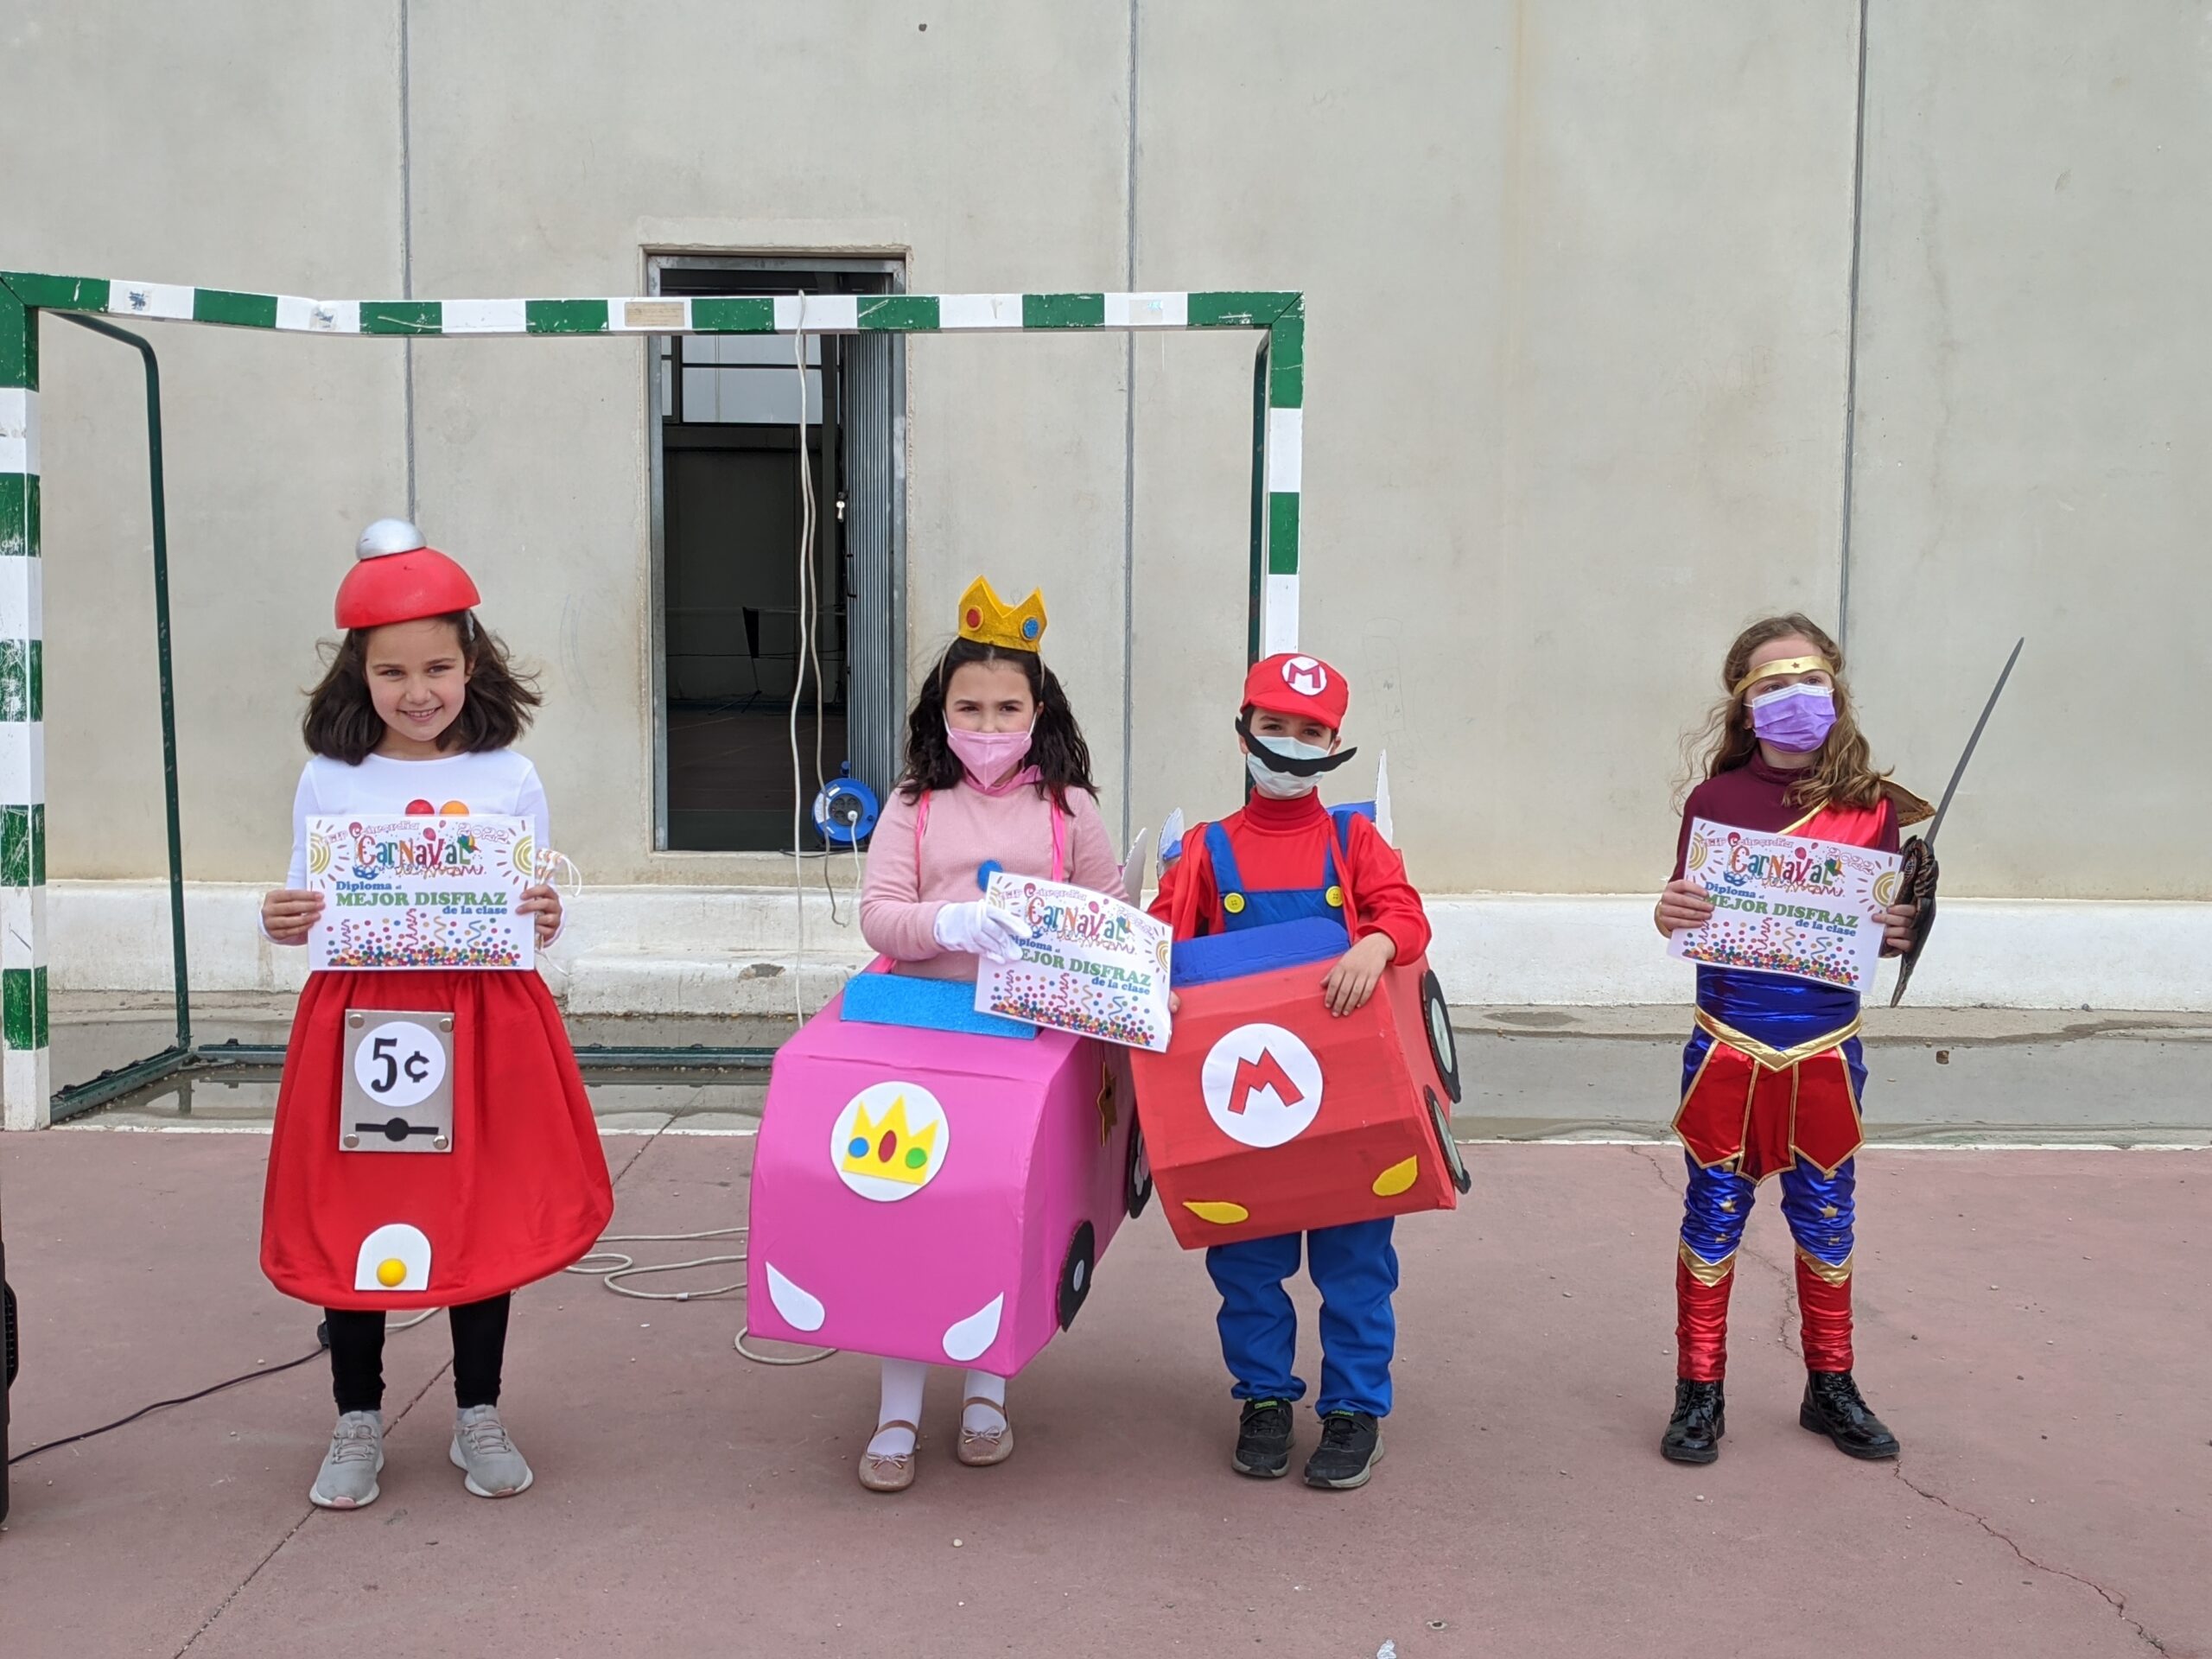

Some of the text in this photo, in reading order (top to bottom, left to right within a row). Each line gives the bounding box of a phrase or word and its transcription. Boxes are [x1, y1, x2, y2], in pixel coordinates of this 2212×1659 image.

[1287, 662, 1321, 689] M
[335, 880, 392, 892] Diploma
[1705, 880, 1757, 899] Diploma
[335, 892, 507, 906] MEJOR DISFRAZ
[442, 906, 508, 915] de la clase
[1772, 903, 1859, 929] DISFRAZ
[1795, 918, 1857, 937] de la clase
[1021, 948, 1152, 988] EJOR DISFRAZ
[1091, 976, 1151, 995] de la clase
[1227, 1046, 1305, 1116] M
